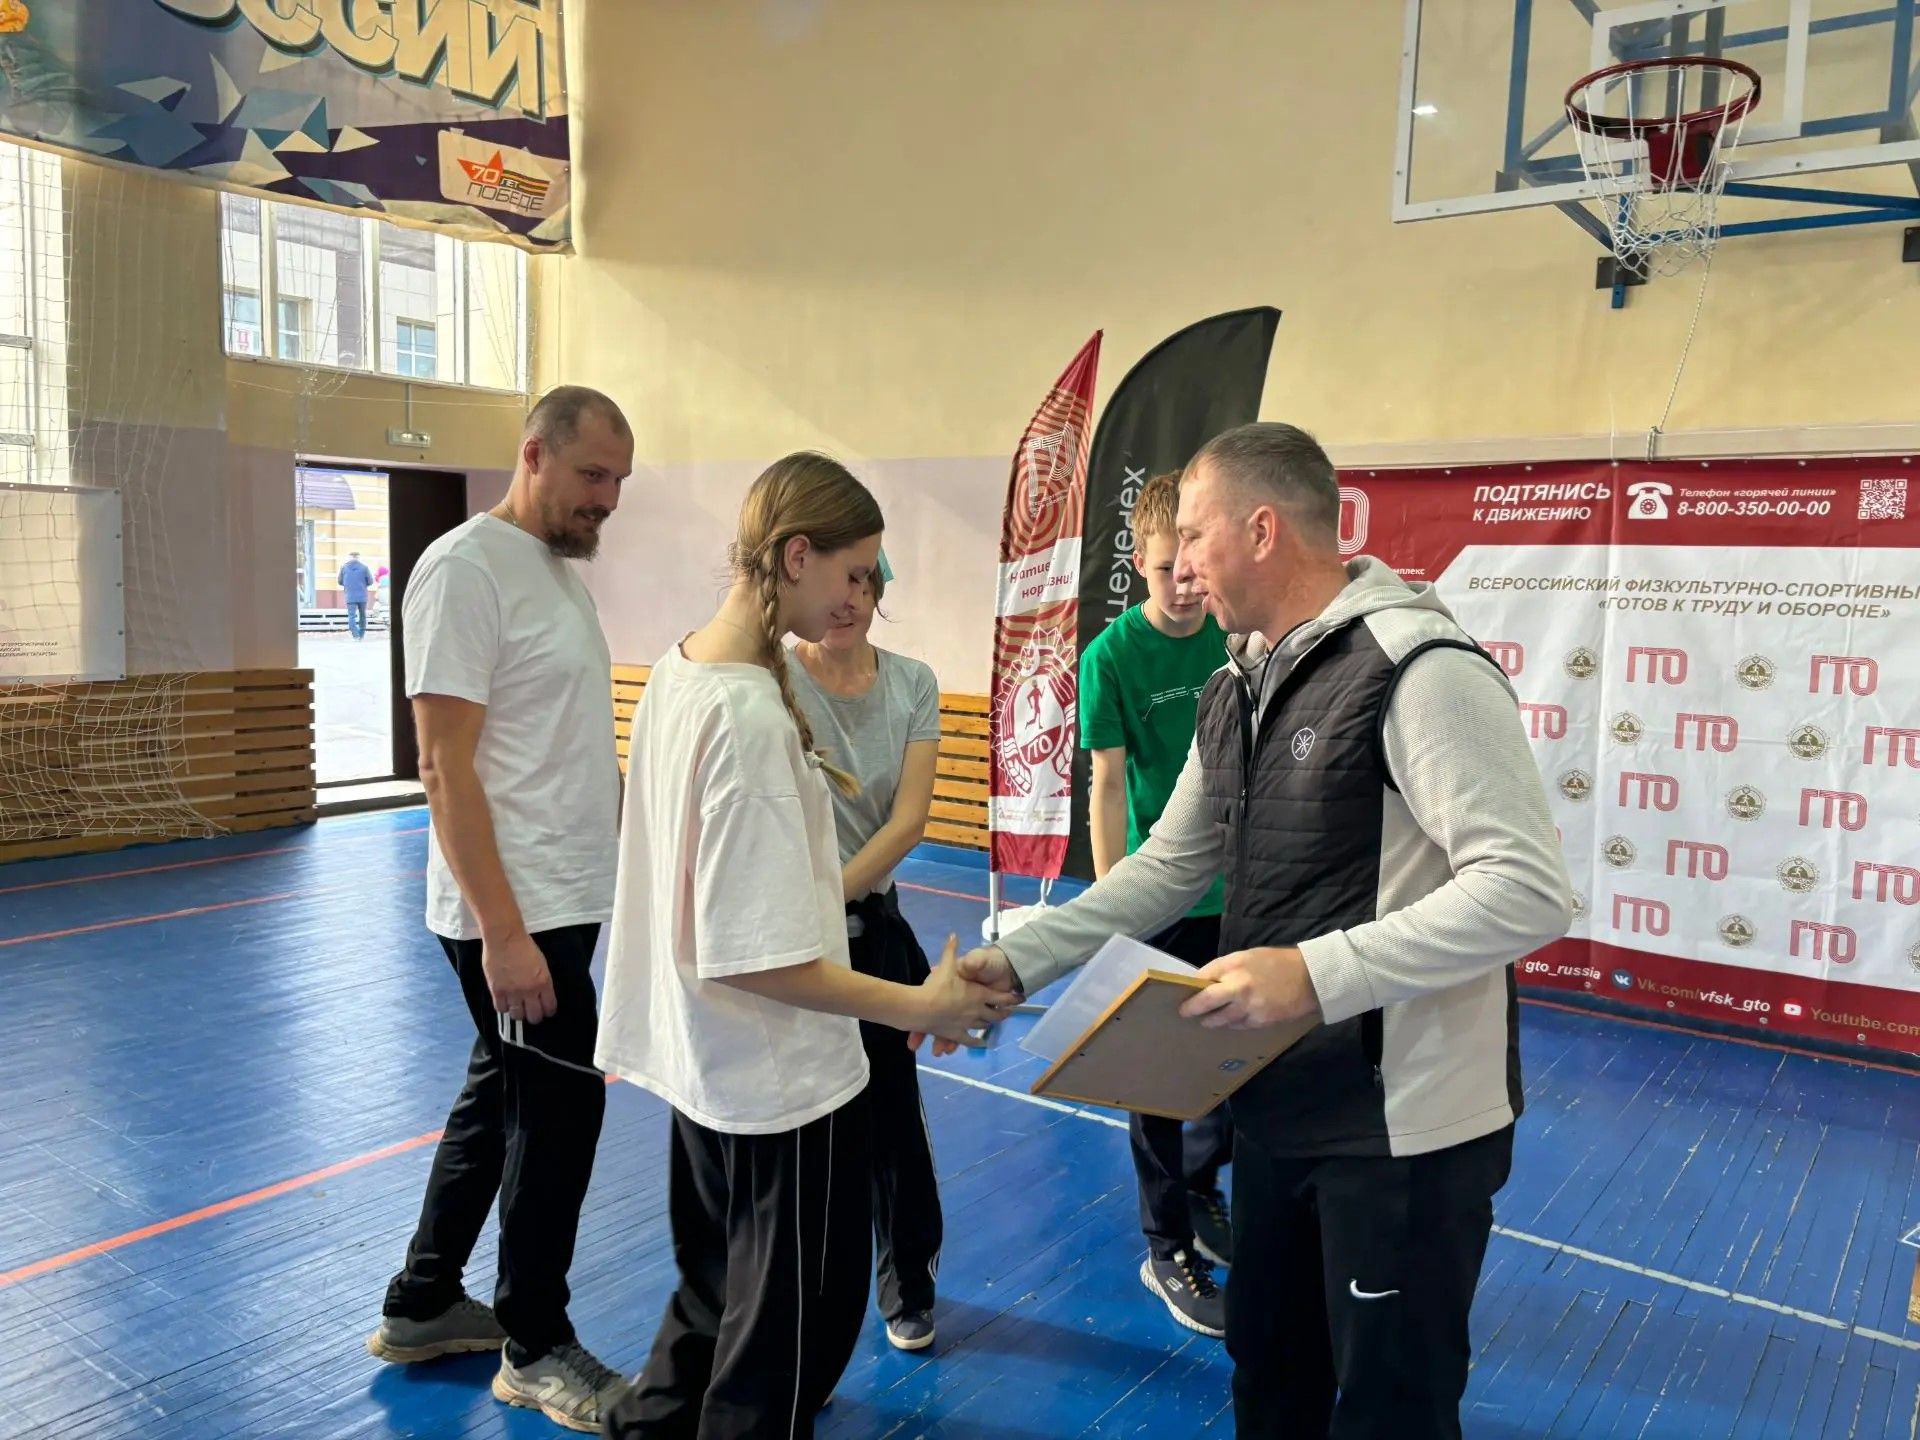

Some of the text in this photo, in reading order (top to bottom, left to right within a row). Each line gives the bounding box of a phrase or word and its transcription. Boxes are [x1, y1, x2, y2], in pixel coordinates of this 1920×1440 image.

[471, 164, 500, 183] 70
[467, 182, 545, 212] ПОБЕДЕ
[1473, 483, 1612, 505] ПОДТЯНИСЬ
[1677, 500, 1831, 516] 8-800-350-00-00
[1679, 488, 1837, 499] Телефон «горячей линии»
[1472, 507, 1592, 524] К ДВИЖЕНИЮ
[1468, 574, 1621, 591] ВСЕРОССИЙСКИЙ
[1598, 597, 1891, 618] «ГОТОВ К ТРУДУ И ОБОРОНЕ»
[1477, 641, 1524, 676] ТО
[1626, 646, 1688, 685] ГТО
[1809, 655, 1879, 696] ГТО
[1675, 712, 1739, 753] ГТО
[1619, 771, 1680, 812] ГТО
[1798, 788, 1868, 831] ГТО
[1666, 839, 1729, 881] ГТО
[1851, 861, 1920, 905] ГТО
[1612, 893, 1670, 937] ГТО
[1789, 919, 1857, 964] ГТО
[1636, 976, 1771, 1012] Vk.com/vfsk_gto
